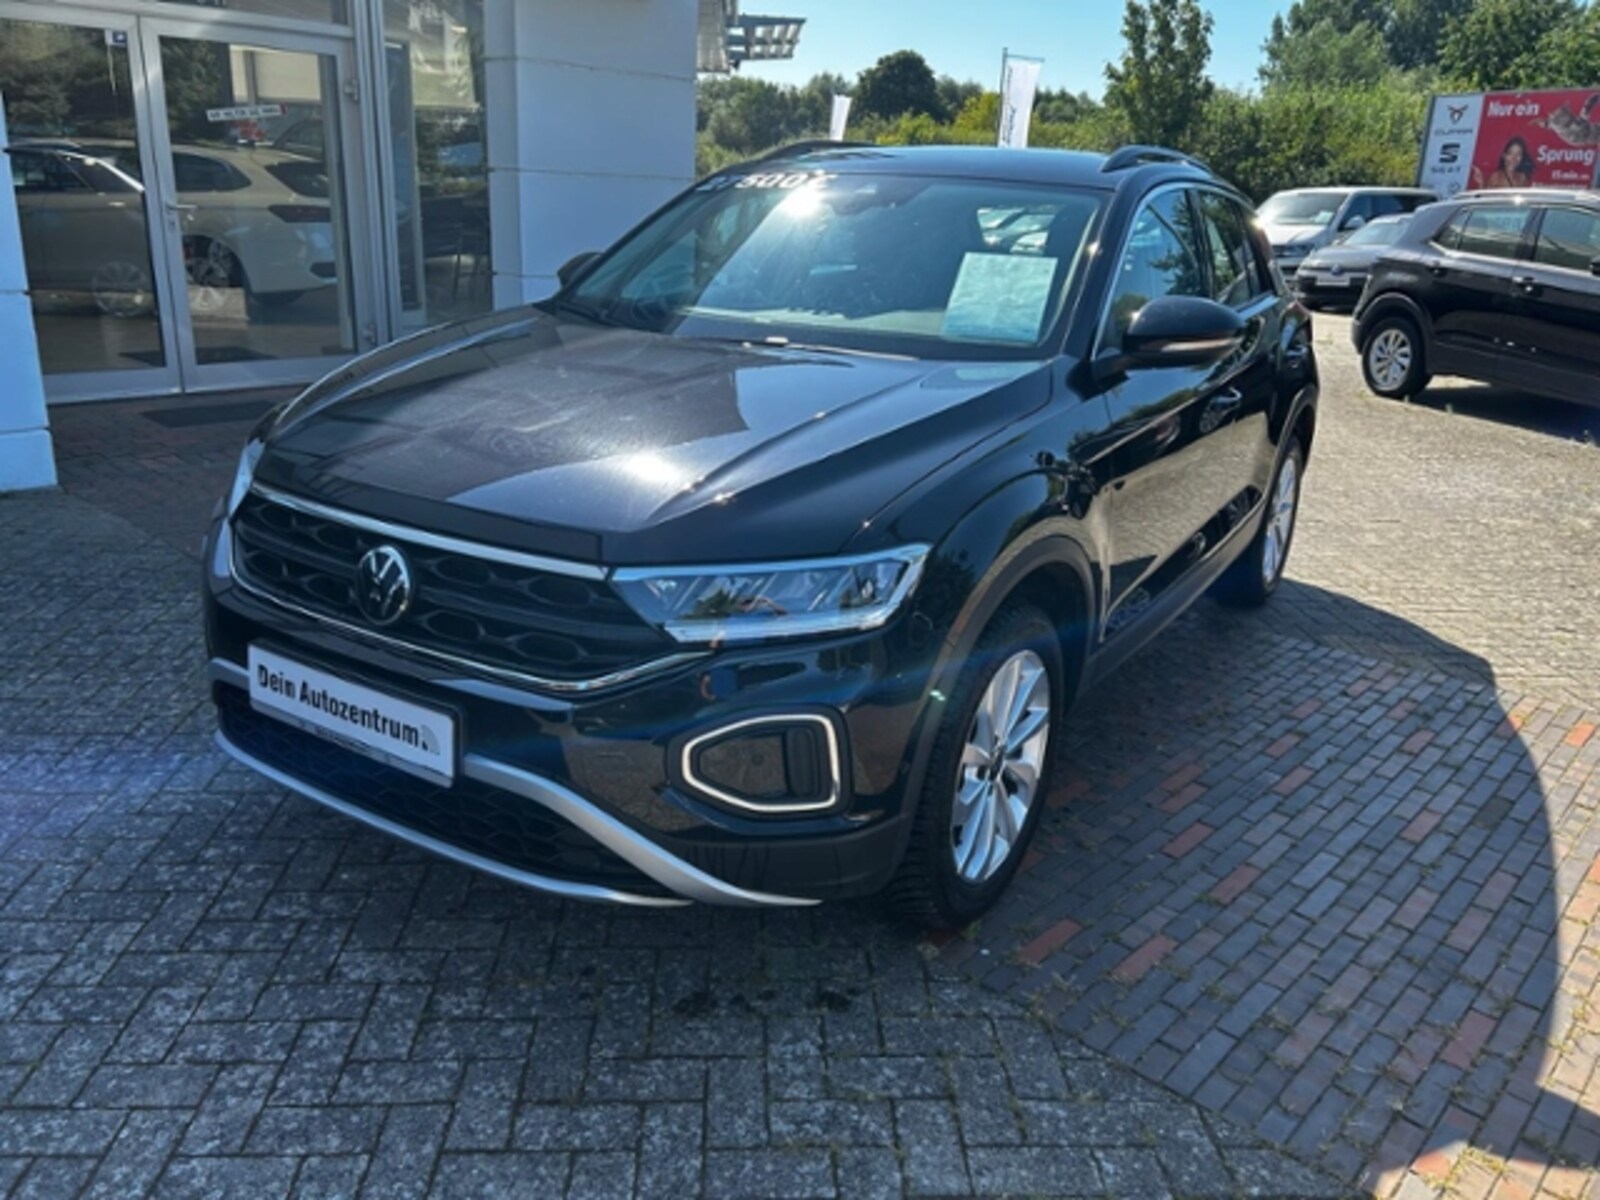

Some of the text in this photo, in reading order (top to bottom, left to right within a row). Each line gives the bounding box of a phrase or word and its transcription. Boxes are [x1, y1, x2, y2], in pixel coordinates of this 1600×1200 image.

[1488, 99, 1540, 116] Nur ein
[1537, 144, 1595, 166] Sprung
[257, 664, 297, 699] Dein
[300, 679, 420, 748] Autozentrum
